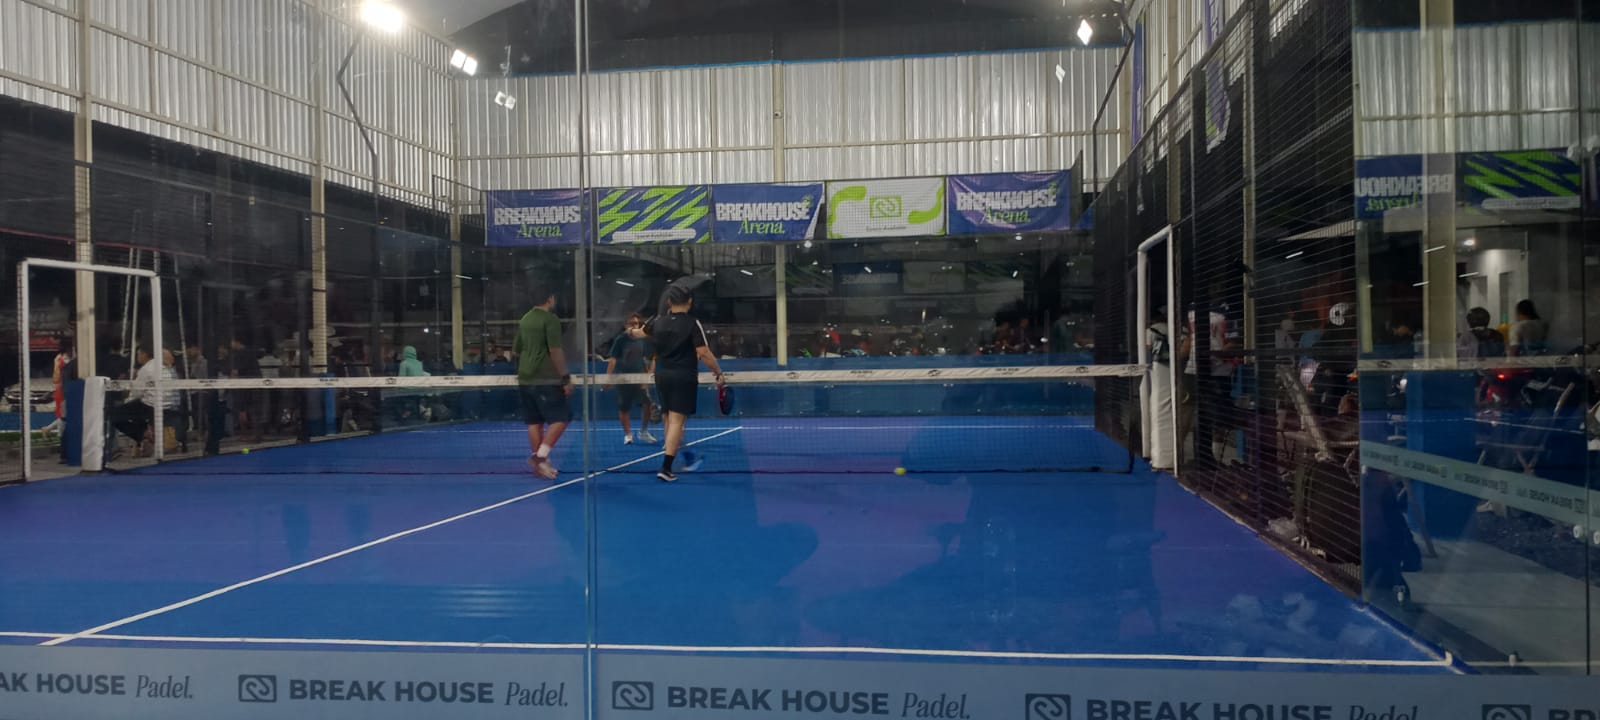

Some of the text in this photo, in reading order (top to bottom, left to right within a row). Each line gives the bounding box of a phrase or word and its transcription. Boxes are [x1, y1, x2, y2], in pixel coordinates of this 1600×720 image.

[494, 205, 581, 225] BREAKHOUS
[738, 219, 785, 234] Arena.
[37, 673, 126, 695] HOUSE
[136, 675, 194, 699] Padel.
[289, 679, 569, 708] BREAK HOUSE Padel.
[667, 686, 971, 719] BREAK HOUSE Padel.
[1087, 699, 1203, 720] BREAK
[1213, 703, 1333, 720] HOUSE
